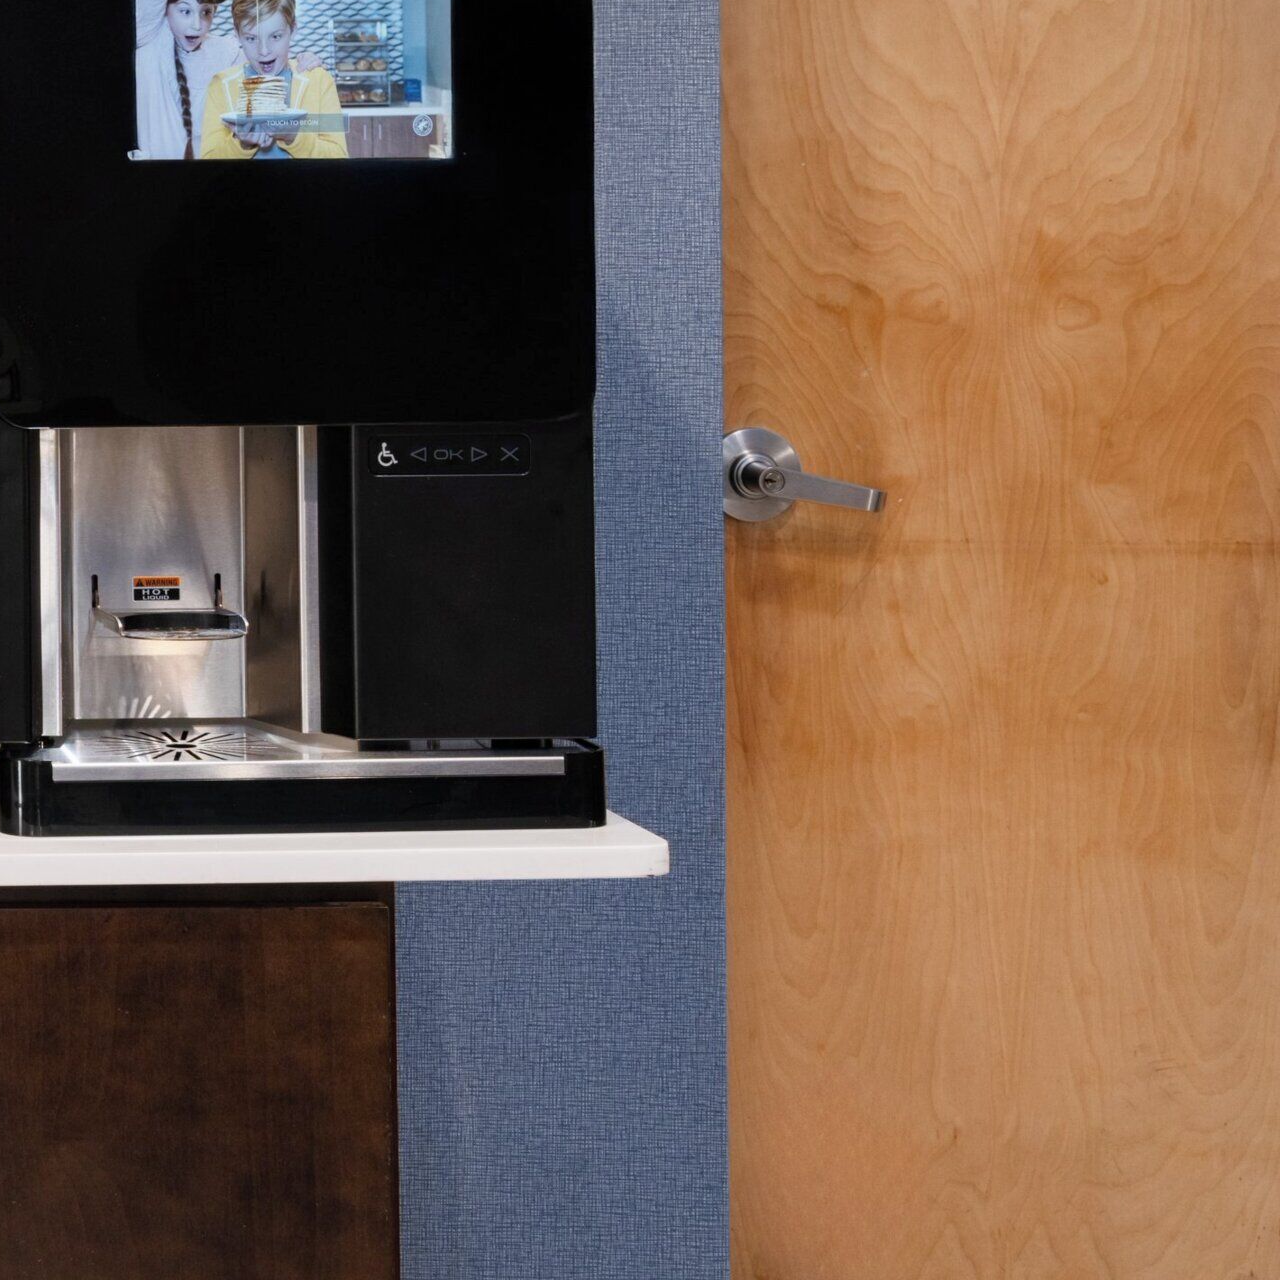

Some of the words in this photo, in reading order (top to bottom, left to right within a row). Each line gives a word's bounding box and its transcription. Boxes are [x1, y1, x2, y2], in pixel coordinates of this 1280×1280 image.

[434, 448, 464, 461] OK
[145, 579, 178, 587] WARNING
[142, 588, 170, 596] HOT
